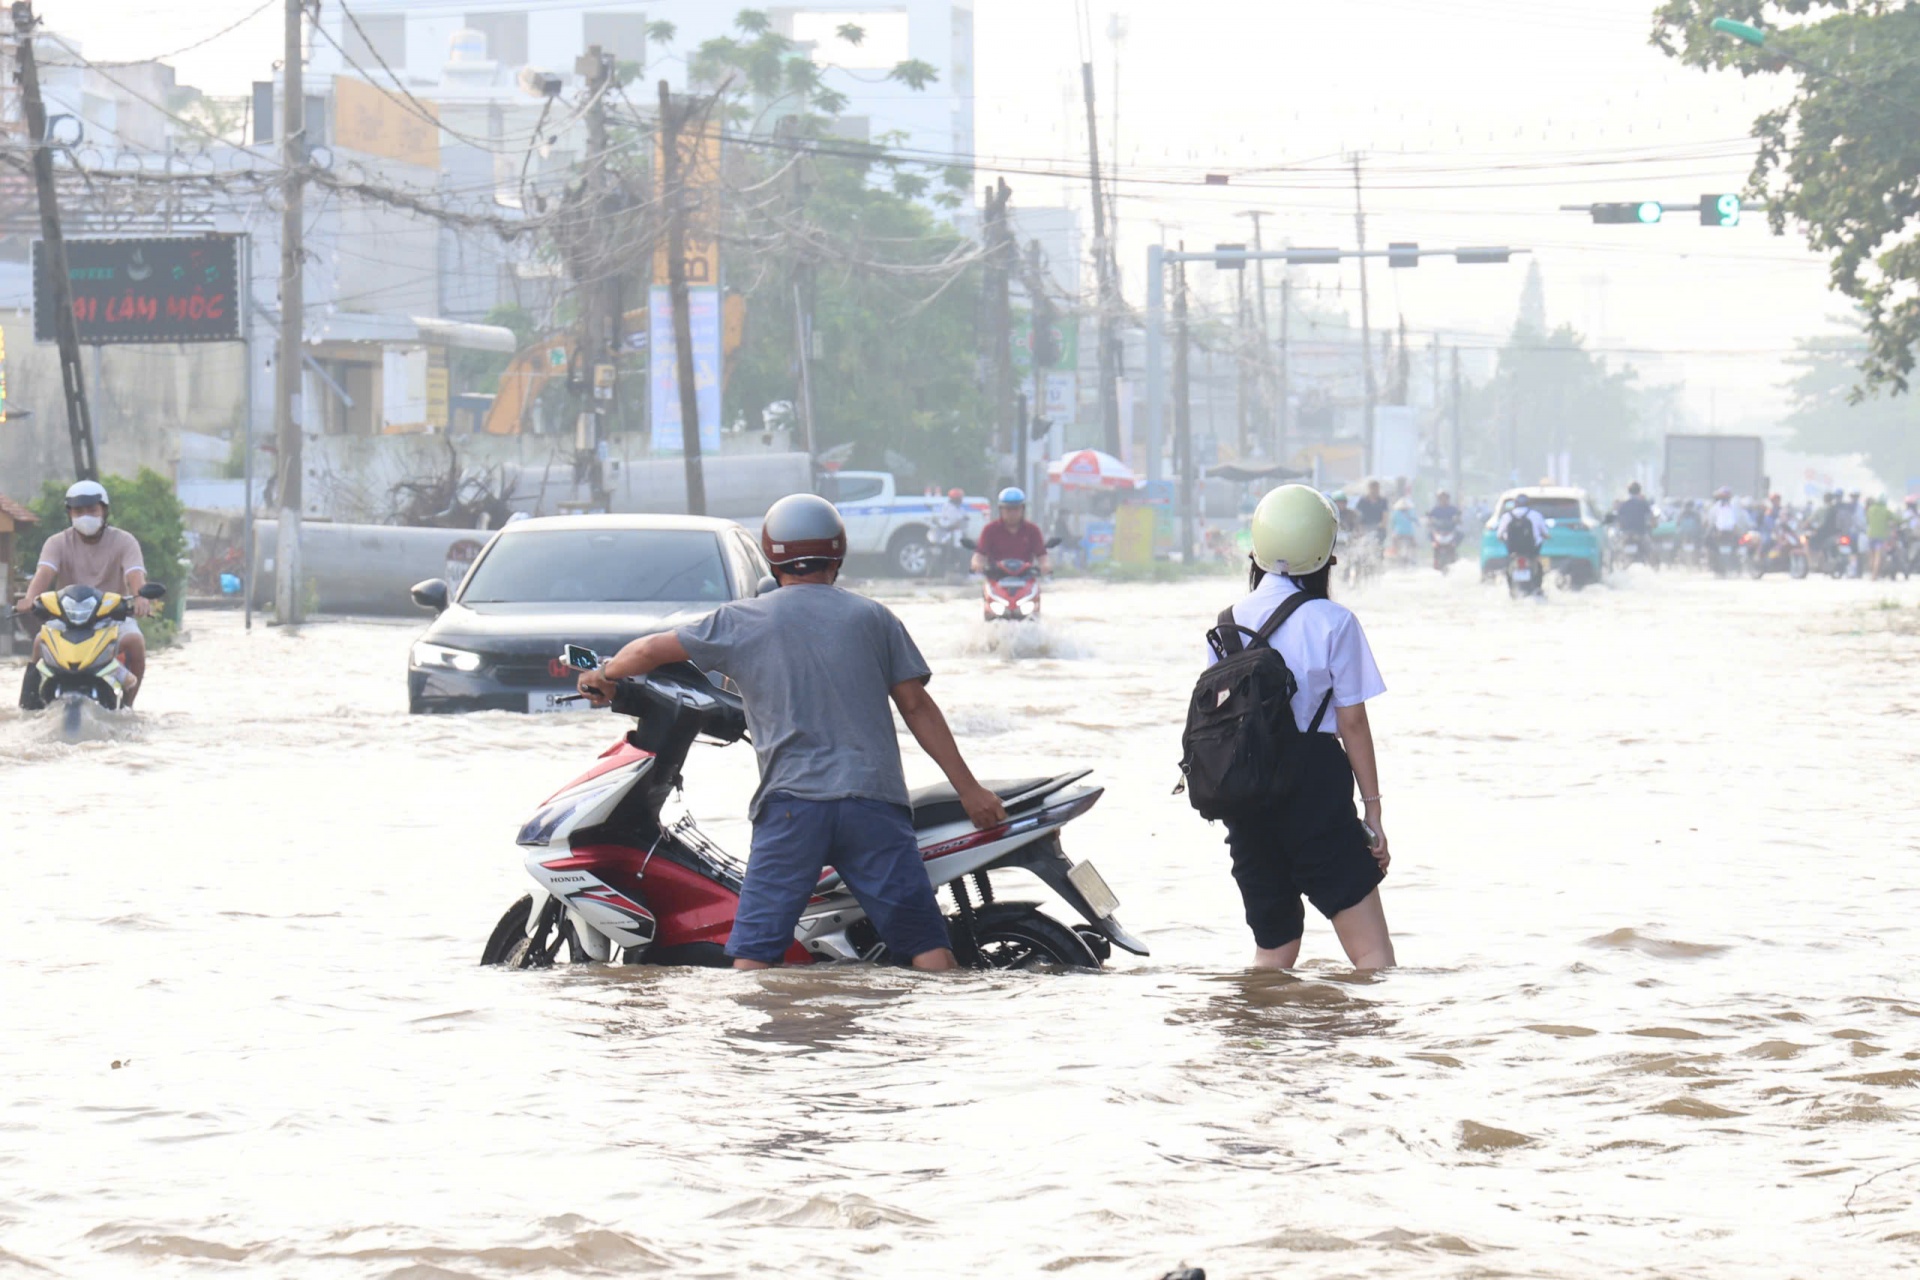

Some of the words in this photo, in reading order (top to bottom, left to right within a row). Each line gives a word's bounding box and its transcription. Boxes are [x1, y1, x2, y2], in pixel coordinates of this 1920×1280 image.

[1717, 194, 1740, 226] 9
[72, 295, 98, 322] AI
[550, 875, 586, 883] HONDA
